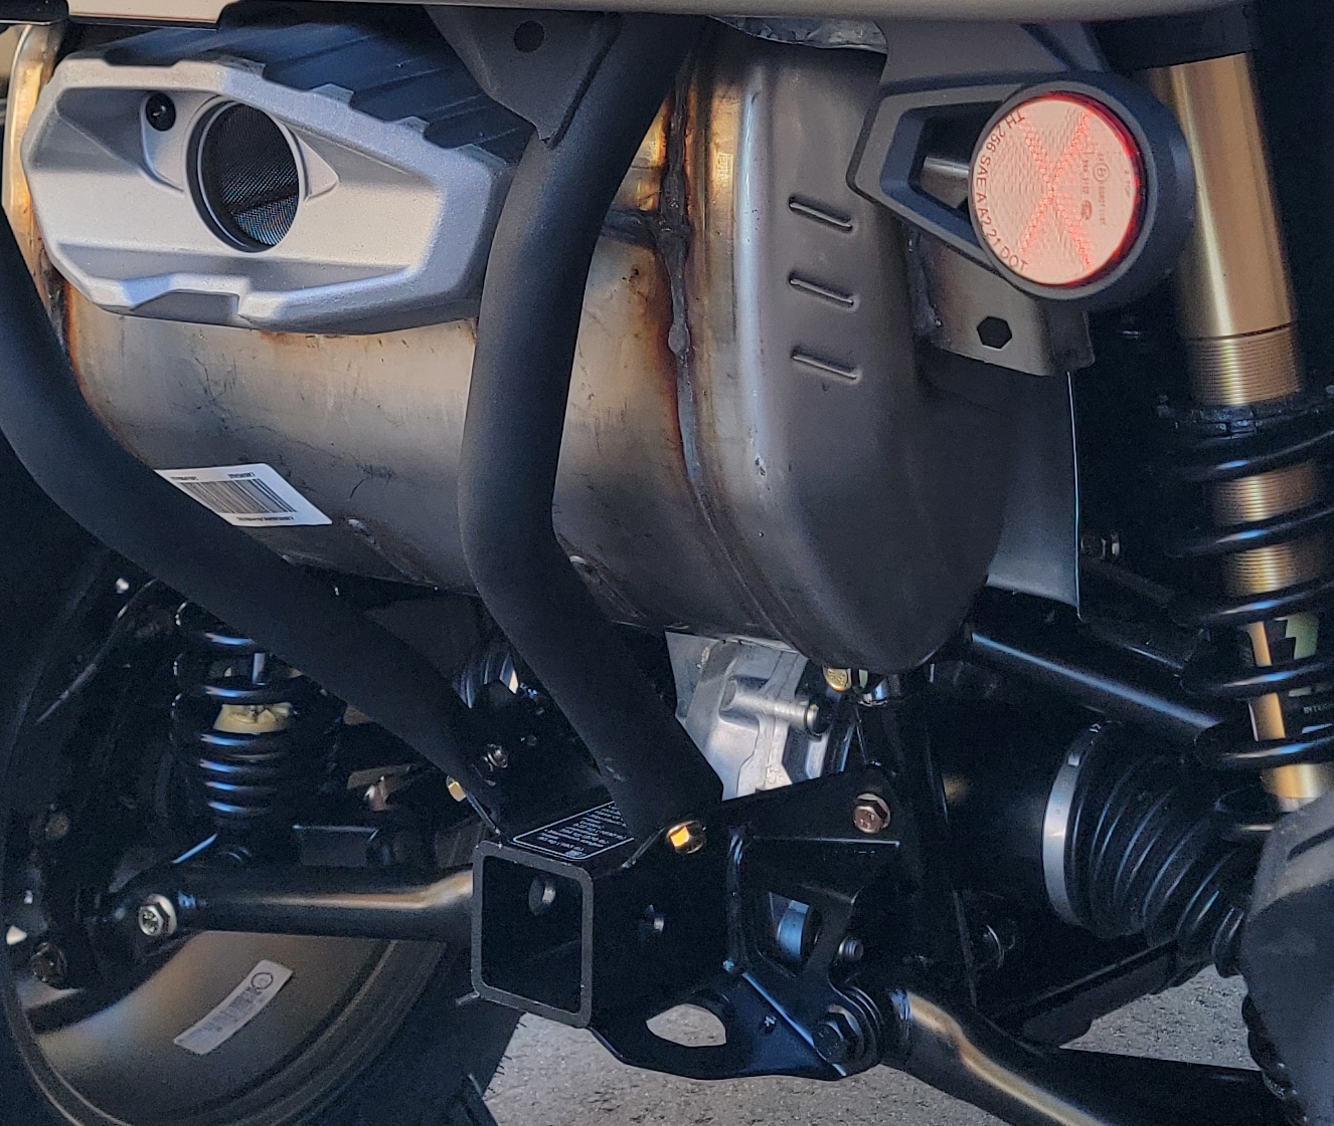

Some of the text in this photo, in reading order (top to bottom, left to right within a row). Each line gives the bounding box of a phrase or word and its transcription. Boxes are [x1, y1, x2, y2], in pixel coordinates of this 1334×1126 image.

[986, 125, 1005, 154] 256
[977, 155, 991, 185] SAE
[976, 191, 986, 205] A
[1000, 246, 1028, 272] DOT
